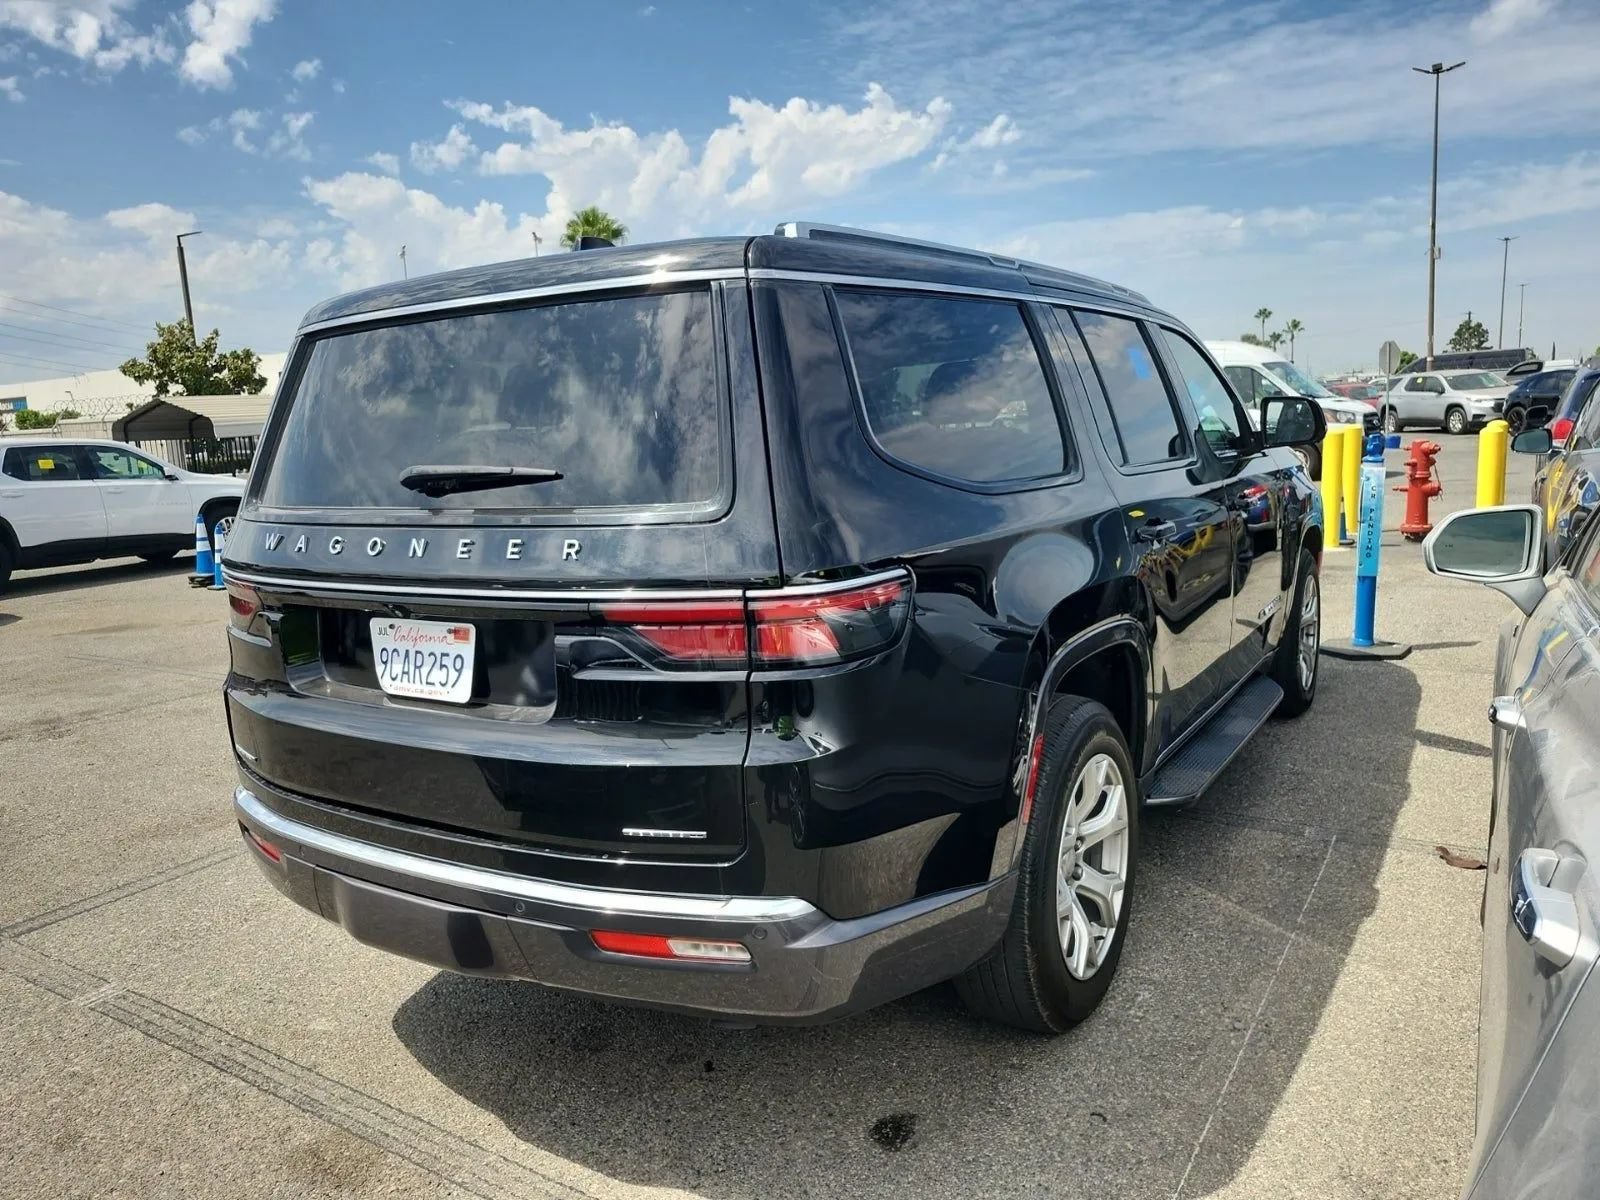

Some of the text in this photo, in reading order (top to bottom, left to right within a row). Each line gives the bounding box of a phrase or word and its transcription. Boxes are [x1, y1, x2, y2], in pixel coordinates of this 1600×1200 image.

[264, 532, 583, 562] WAGONEER
[377, 626, 389, 636] JUL
[393, 625, 455, 648] California
[380, 647, 465, 689] 9CAR259
